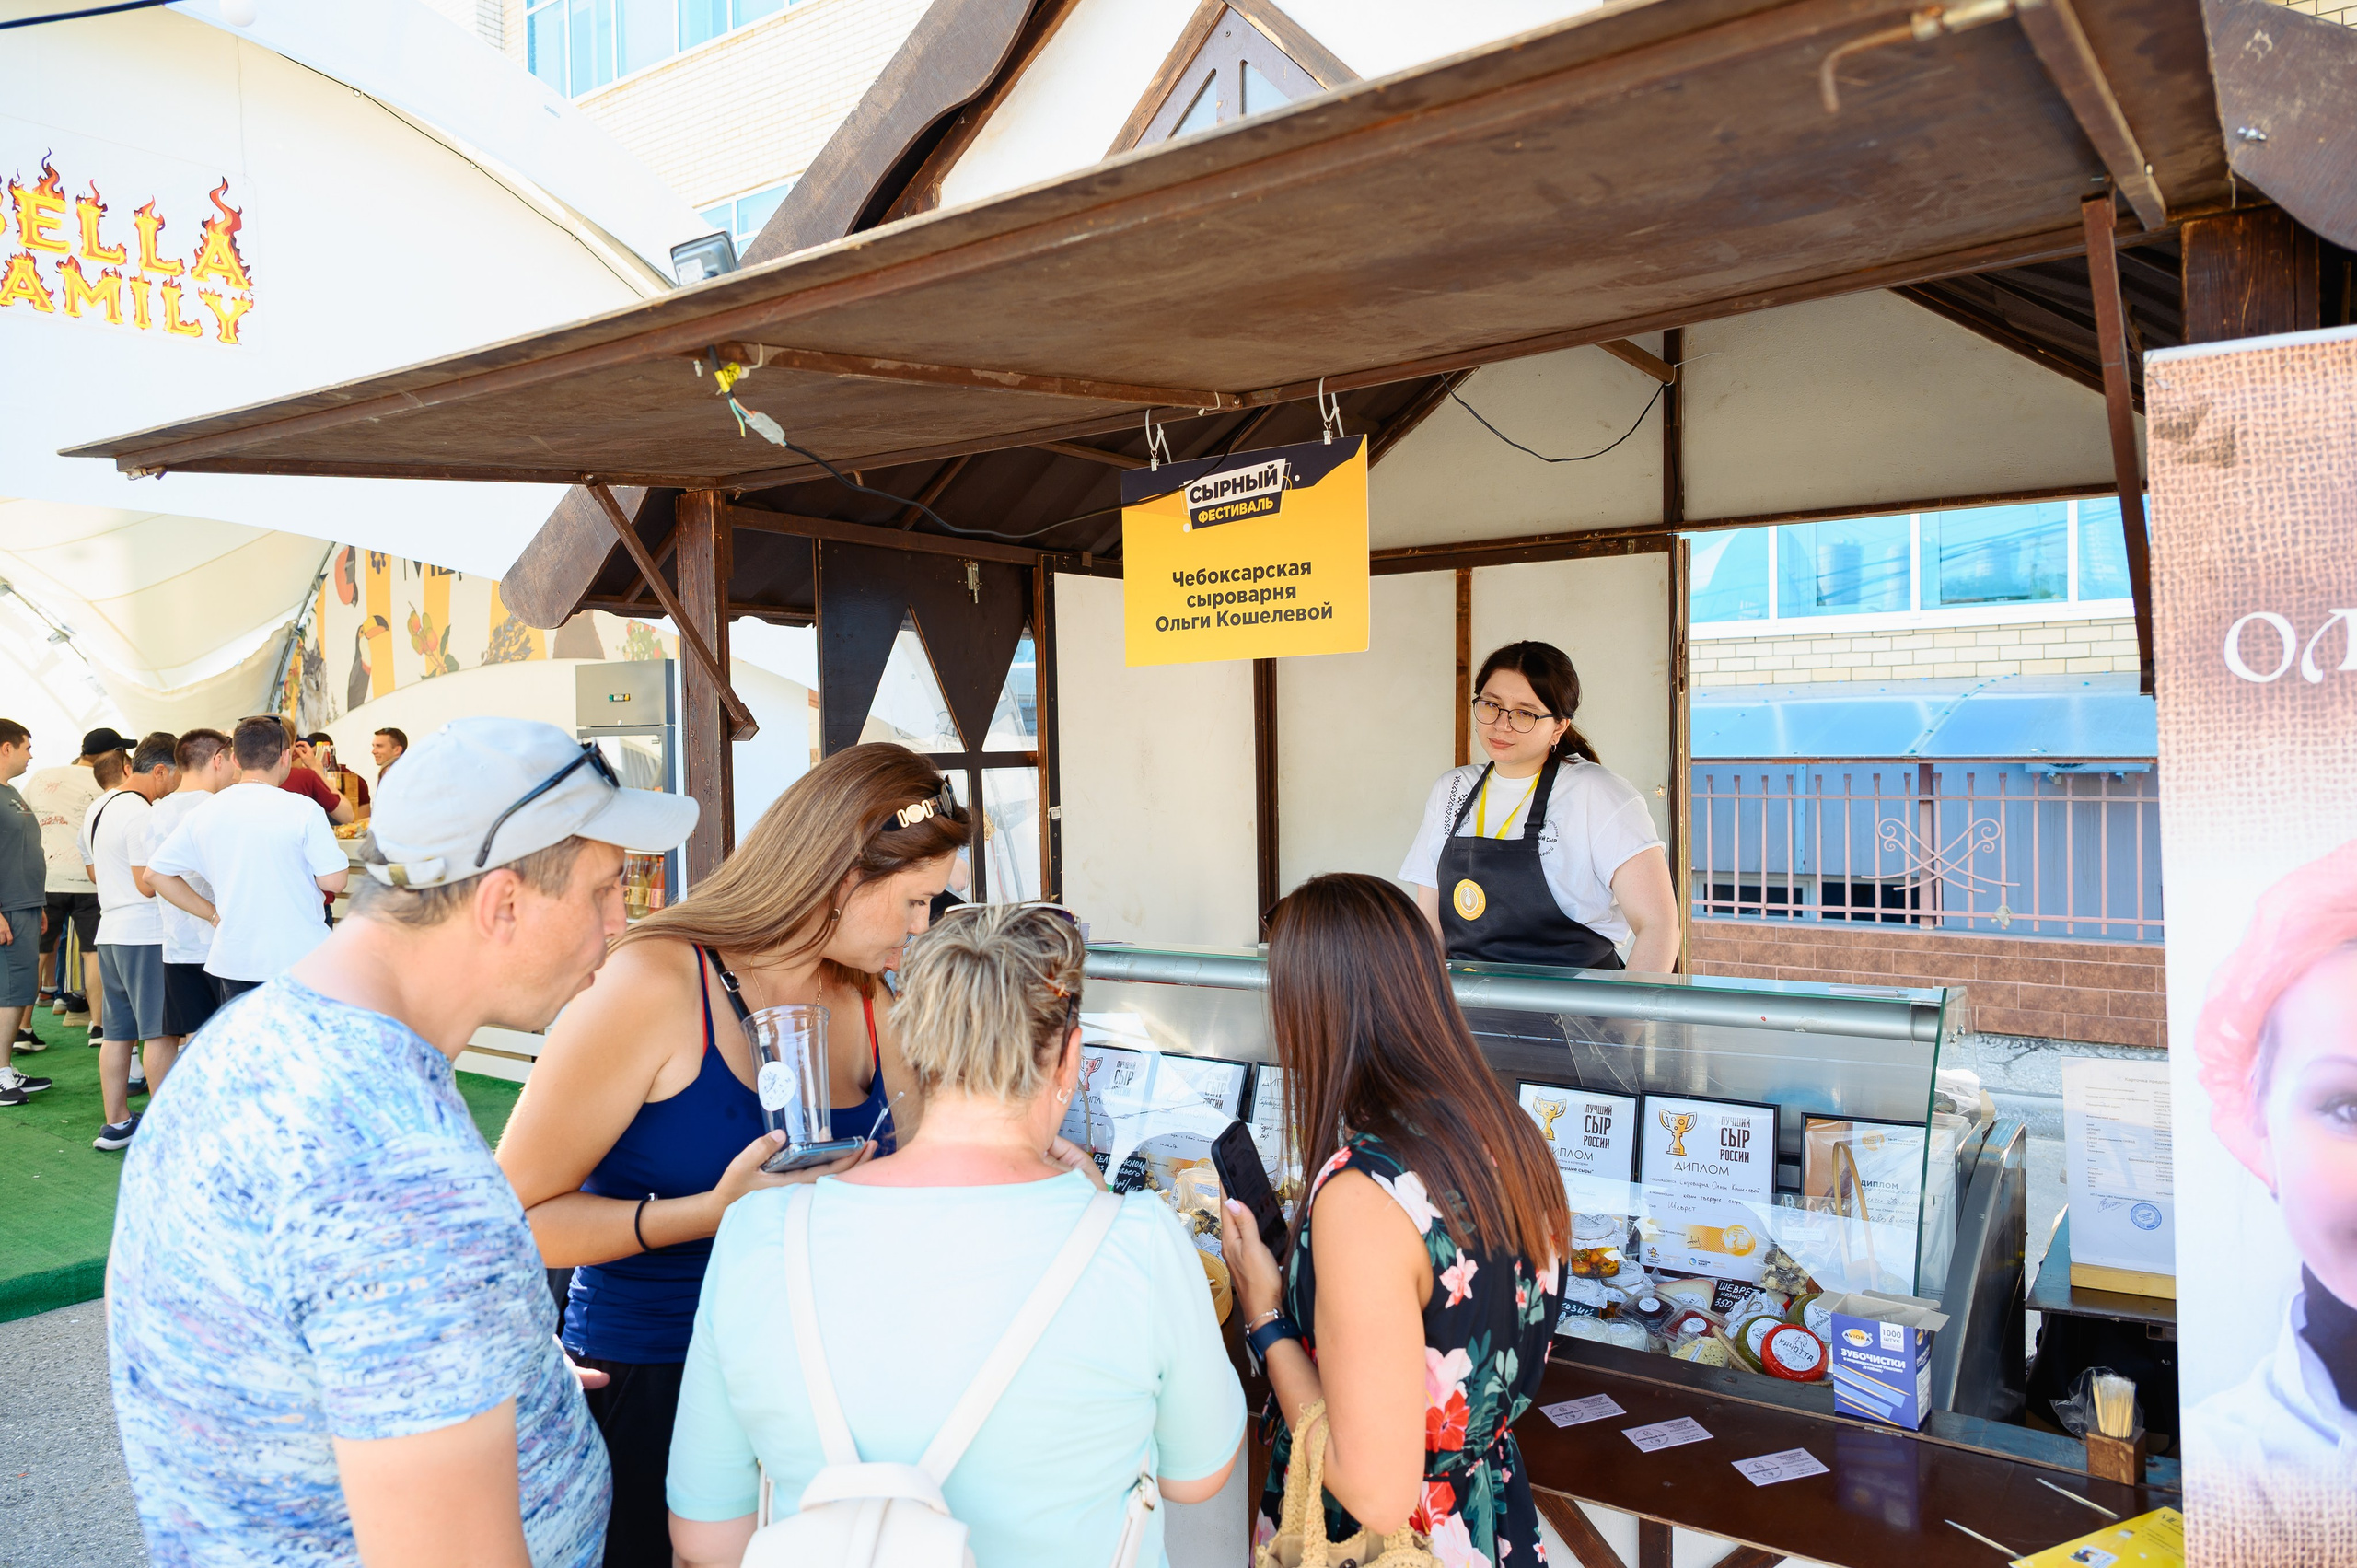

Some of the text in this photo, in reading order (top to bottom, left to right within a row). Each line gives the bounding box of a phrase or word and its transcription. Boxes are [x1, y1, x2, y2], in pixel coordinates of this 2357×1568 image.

[1190, 464, 1278, 504] СЫРНЫЙ
[1198, 496, 1274, 524] ФЕСТИВАЛЬ
[1172, 561, 1312, 587] Чебоксарская
[1186, 585, 1297, 609] сыроварня
[1155, 601, 1333, 633] Ольги Кошелевой
[1114, 1069, 1134, 1086] СЫР
[1585, 1104, 1612, 1116] ЛУЧШИЙ
[1584, 1115, 1612, 1135] СЫР
[1721, 1116, 1751, 1128] ЛУЧШИЙ
[1583, 1135, 1610, 1149] РОССИИ
[1720, 1127, 1750, 1148] СЫР
[1551, 1146, 1594, 1161] ИПЛОМ
[1719, 1149, 1750, 1163] РОССИИ
[1673, 1161, 1729, 1176] ДИПЛОМ
[1861, 1179, 1898, 1190] ДИПЛОМ
[1844, 1332, 1871, 1342] AVIORA
[1882, 1329, 1902, 1339] 1000
[1778, 1338, 1814, 1363] КАЧОТТА
[1840, 1348, 1906, 1369] ЗУБОЧИСТКИ
